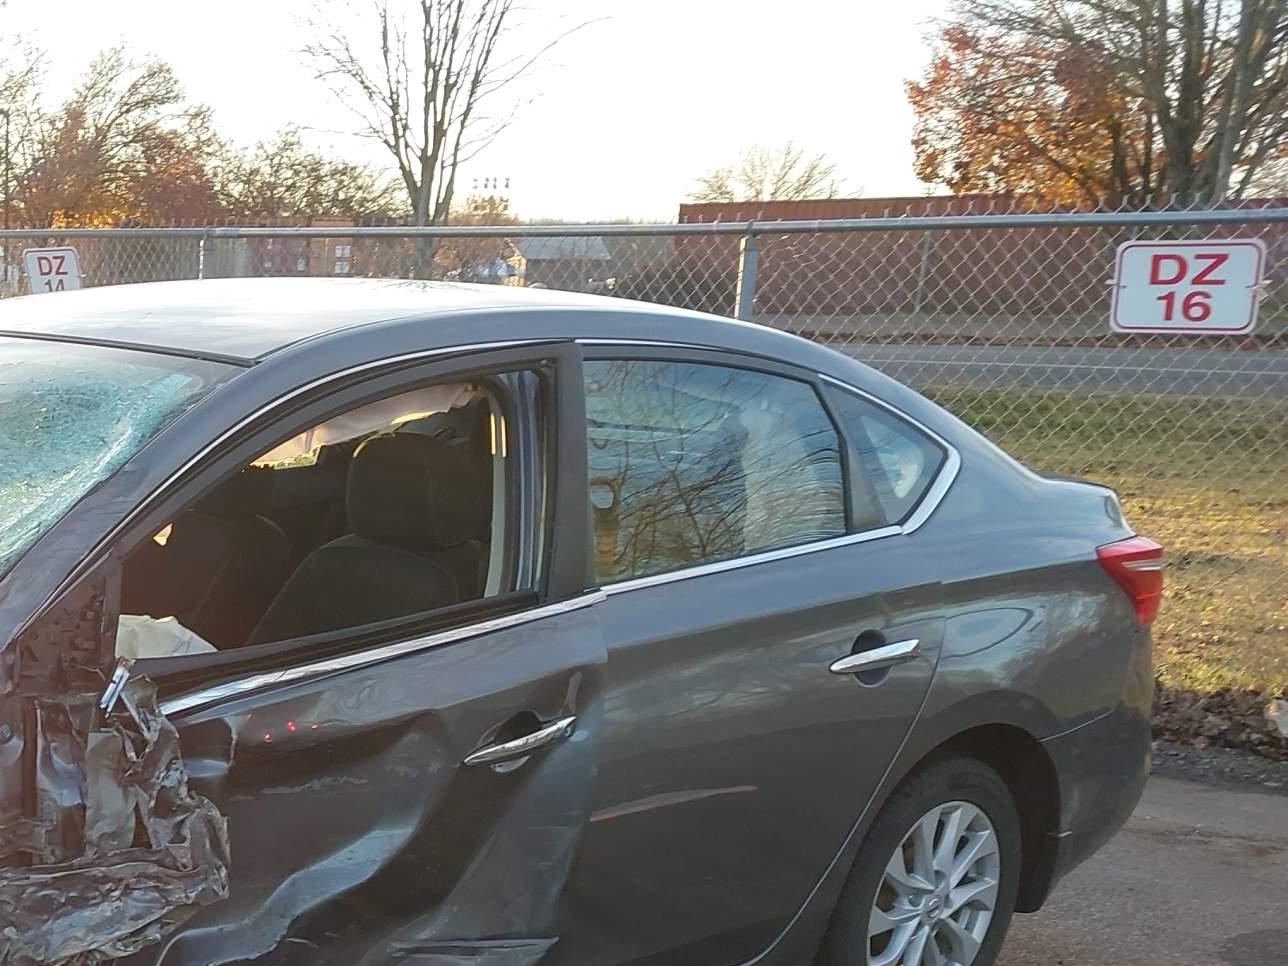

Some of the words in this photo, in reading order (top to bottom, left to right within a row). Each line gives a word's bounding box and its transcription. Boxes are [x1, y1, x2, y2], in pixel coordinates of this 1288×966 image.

[37, 255, 68, 276] DZ
[1149, 253, 1230, 285] DZ
[44, 279, 65, 292] 14
[1156, 291, 1213, 322] 16
